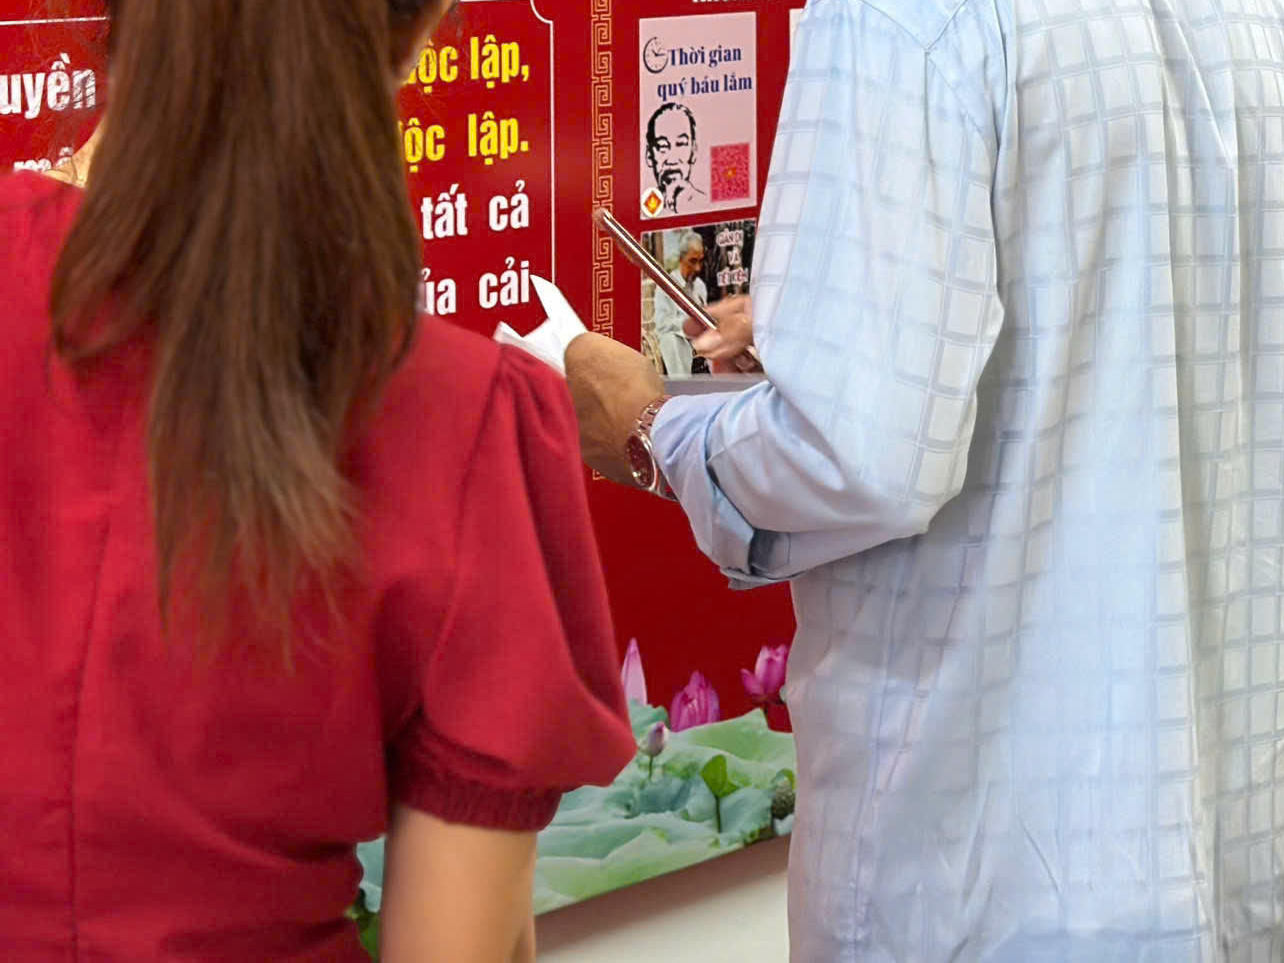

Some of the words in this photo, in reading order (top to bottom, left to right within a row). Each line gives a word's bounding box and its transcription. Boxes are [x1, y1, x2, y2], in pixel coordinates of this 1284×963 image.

[470, 34, 529, 89] lập,
[667, 46, 705, 66] Thời
[709, 45, 742, 68] gian
[657, 77, 687, 101] quý
[691, 75, 720, 95] báu
[724, 71, 753, 91] lắm
[398, 117, 446, 173] ộc
[467, 111, 529, 165] lập.
[421, 184, 468, 239] tất
[489, 180, 529, 231] cả
[478, 256, 530, 309] cải
